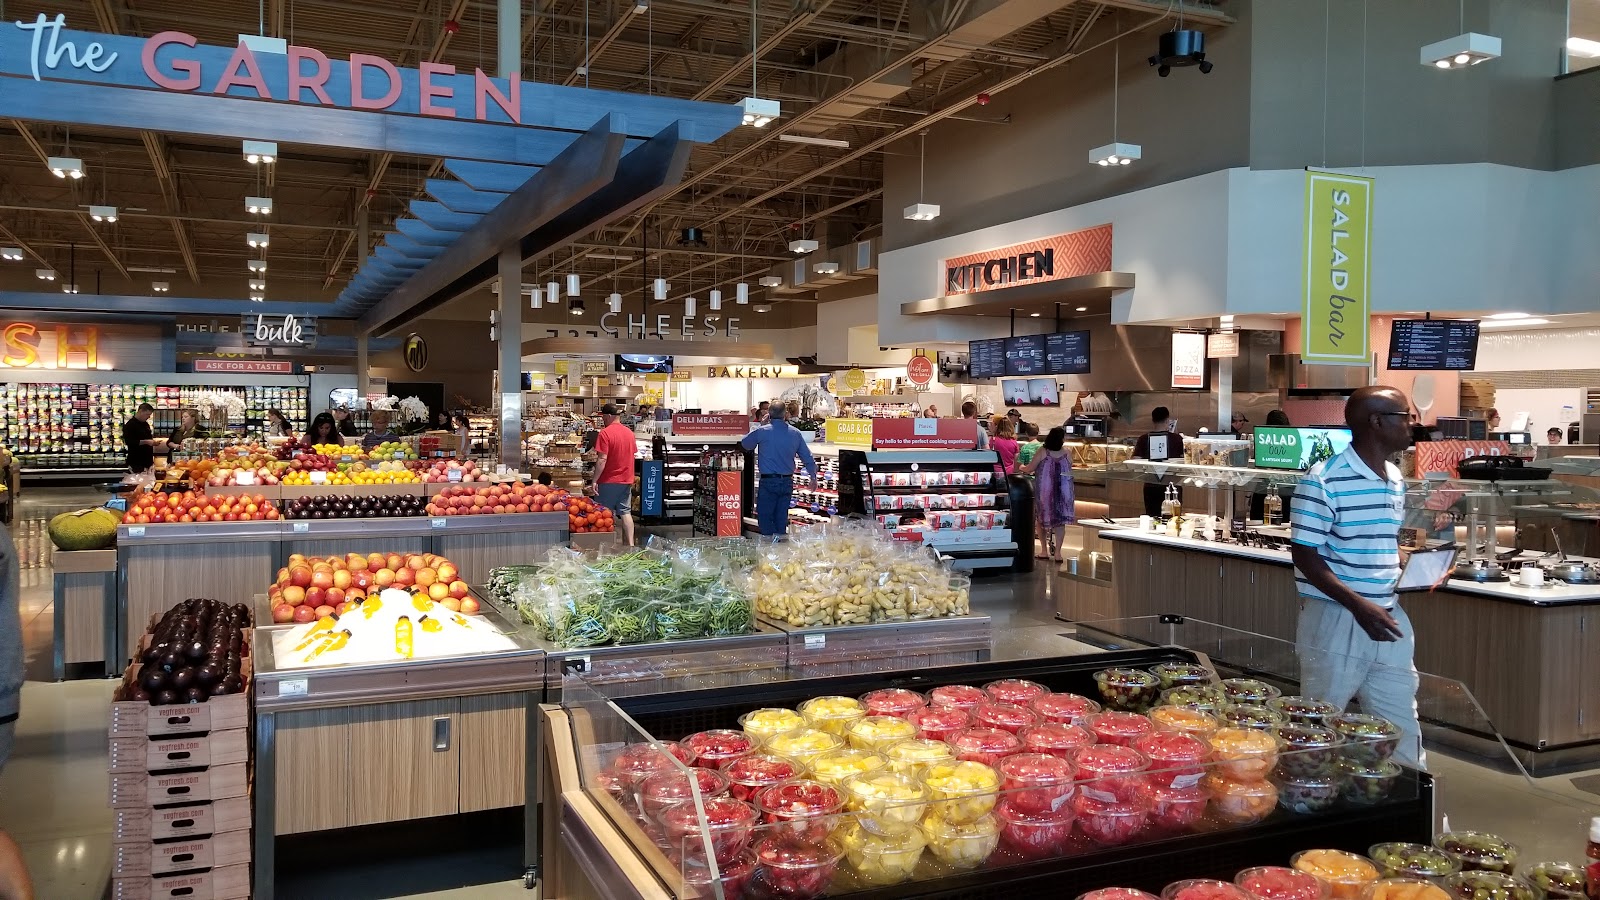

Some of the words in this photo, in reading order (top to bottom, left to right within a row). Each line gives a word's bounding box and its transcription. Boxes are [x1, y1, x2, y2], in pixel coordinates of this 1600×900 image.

[16, 13, 117, 81] the
[141, 31, 521, 124] GARDEN
[1331, 188, 1350, 291] SALAD
[948, 248, 1054, 292] KITCHEN
[600, 312, 740, 339] CHEESE
[1328, 294, 1356, 348] bar
[255, 313, 304, 343] bulk
[226, 362, 244, 370] FOR
[707, 366, 782, 379] BAKERY
[676, 416, 694, 424] DELI
[696, 416, 723, 424] MEATS
[837, 422, 855, 434] GRAB
[856, 423, 862, 434] &
[863, 423, 872, 435] GO
[1258, 433, 1297, 446] SALAD
[648, 477, 656, 499] LIFE
[159, 706, 200, 717] vegfresh.com
[158, 741, 199, 752] vegfresh.com
[157, 776, 199, 787] vegfresh.com
[163, 808, 204, 820] vegfresh.com
[163, 843, 203, 854] vegfresh.com
[161, 877, 203, 888] vegfresh.com
